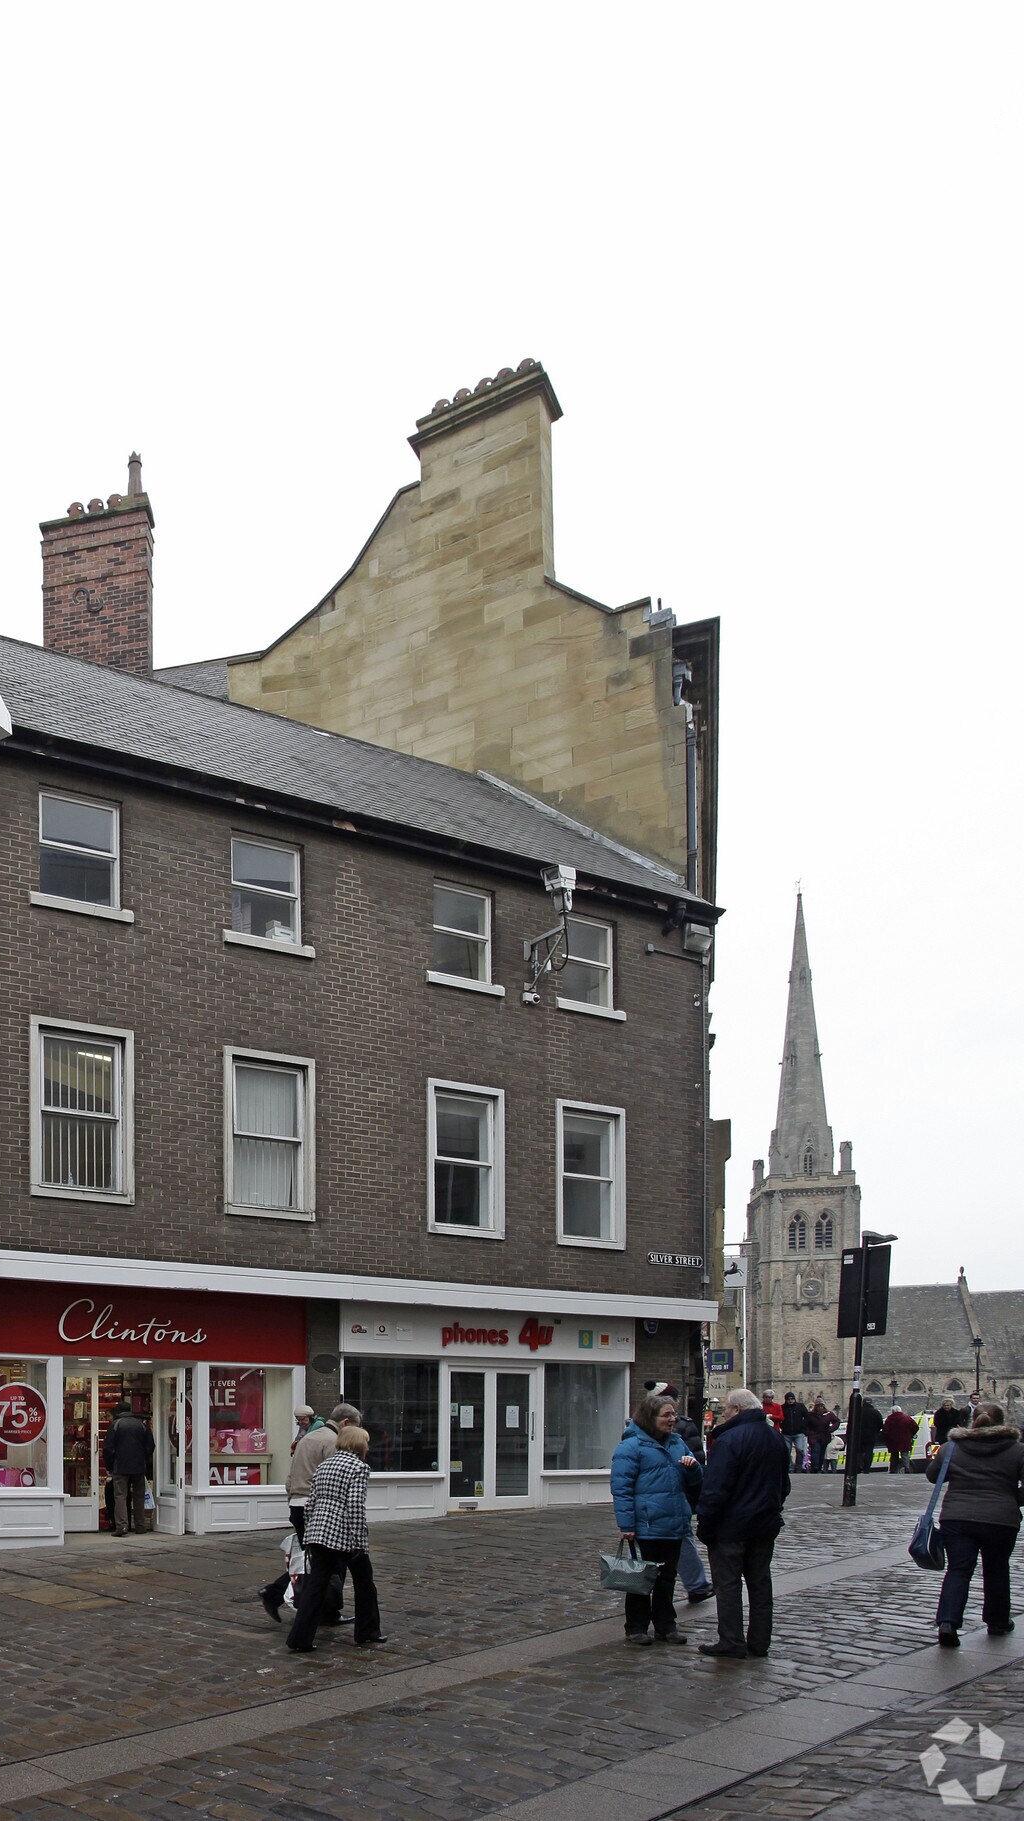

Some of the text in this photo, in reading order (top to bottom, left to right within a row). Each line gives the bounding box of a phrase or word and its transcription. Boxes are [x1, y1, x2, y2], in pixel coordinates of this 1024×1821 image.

[650, 1253, 700, 1266] SILVER STREET
[58, 1298, 207, 1345] Clintons
[441, 1321, 509, 1347] phones
[518, 1317, 554, 1352] 4u
[217, 1379, 237, 1387] EVER
[28, 1406, 38, 1417] %
[209, 1466, 249, 1485] ALE
